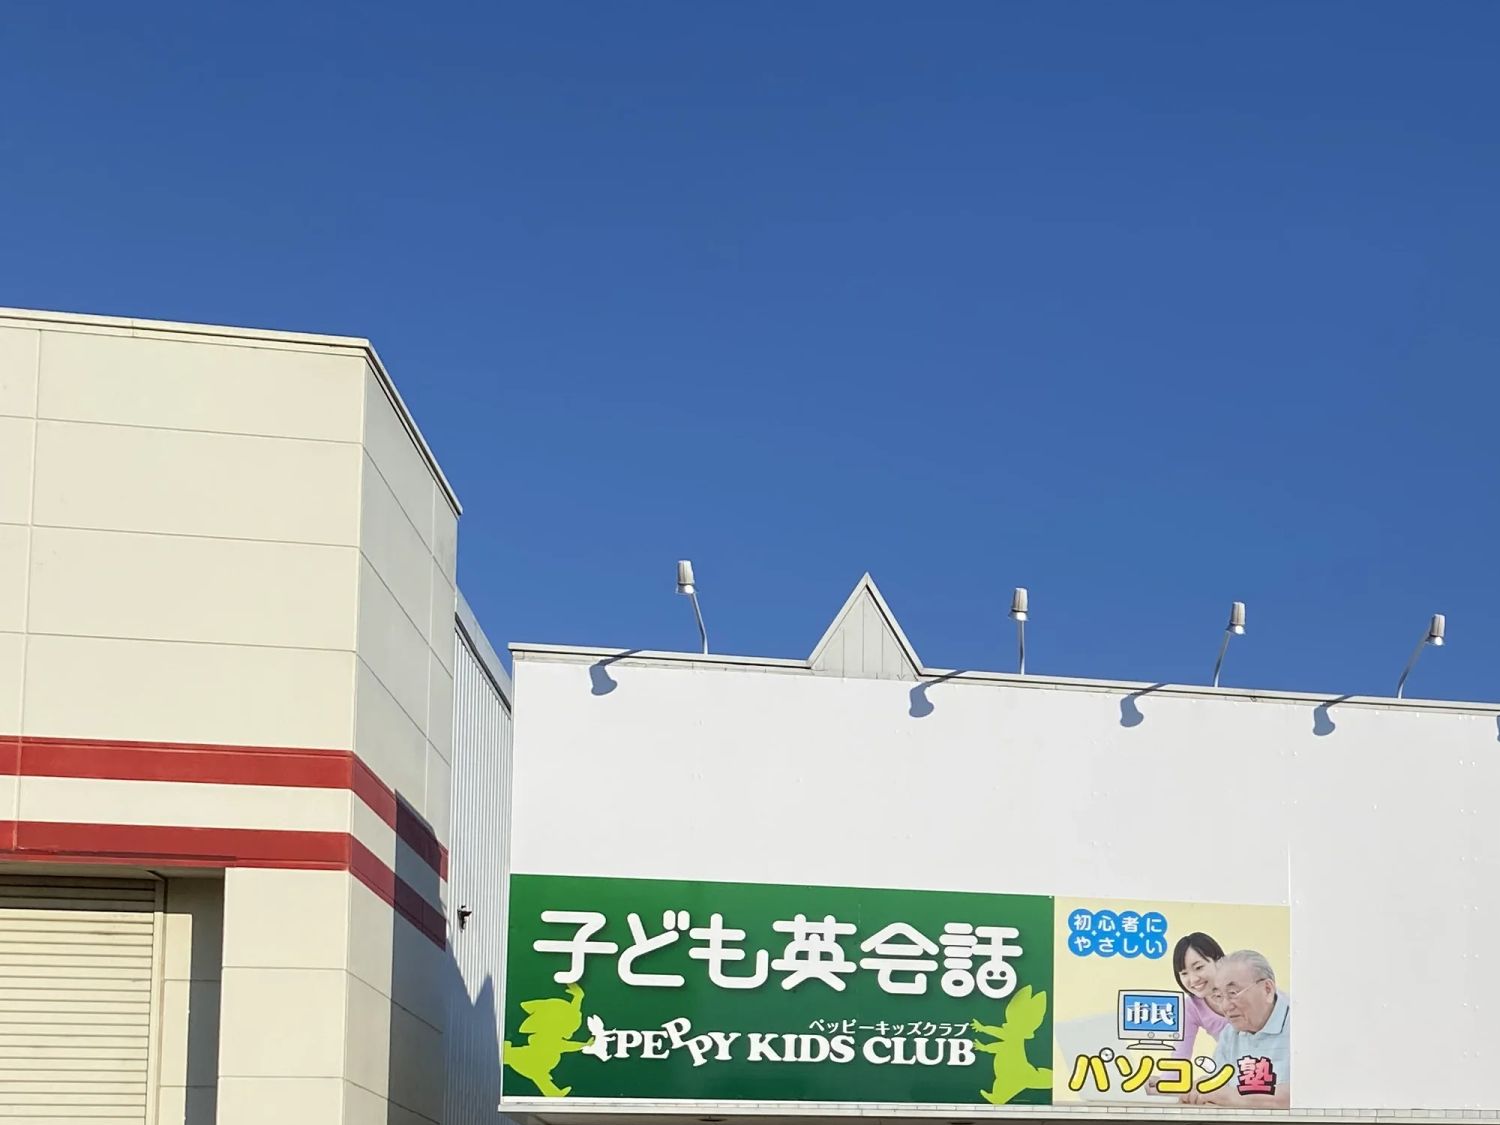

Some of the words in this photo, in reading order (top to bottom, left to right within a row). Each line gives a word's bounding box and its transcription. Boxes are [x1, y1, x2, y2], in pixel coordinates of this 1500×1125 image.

[1073, 914, 1163, 933] 初心者に
[533, 909, 1023, 999] 子ども英会話
[1073, 937, 1163, 954] やさしい
[1126, 1001, 1177, 1026] 市民
[808, 1018, 970, 1037] ペッピーキッズクラブ
[614, 1017, 742, 1066] PEPPY
[747, 1032, 855, 1064] KIDS
[862, 1034, 977, 1067] CLUB
[1068, 1047, 1277, 1096] パソコン塾
